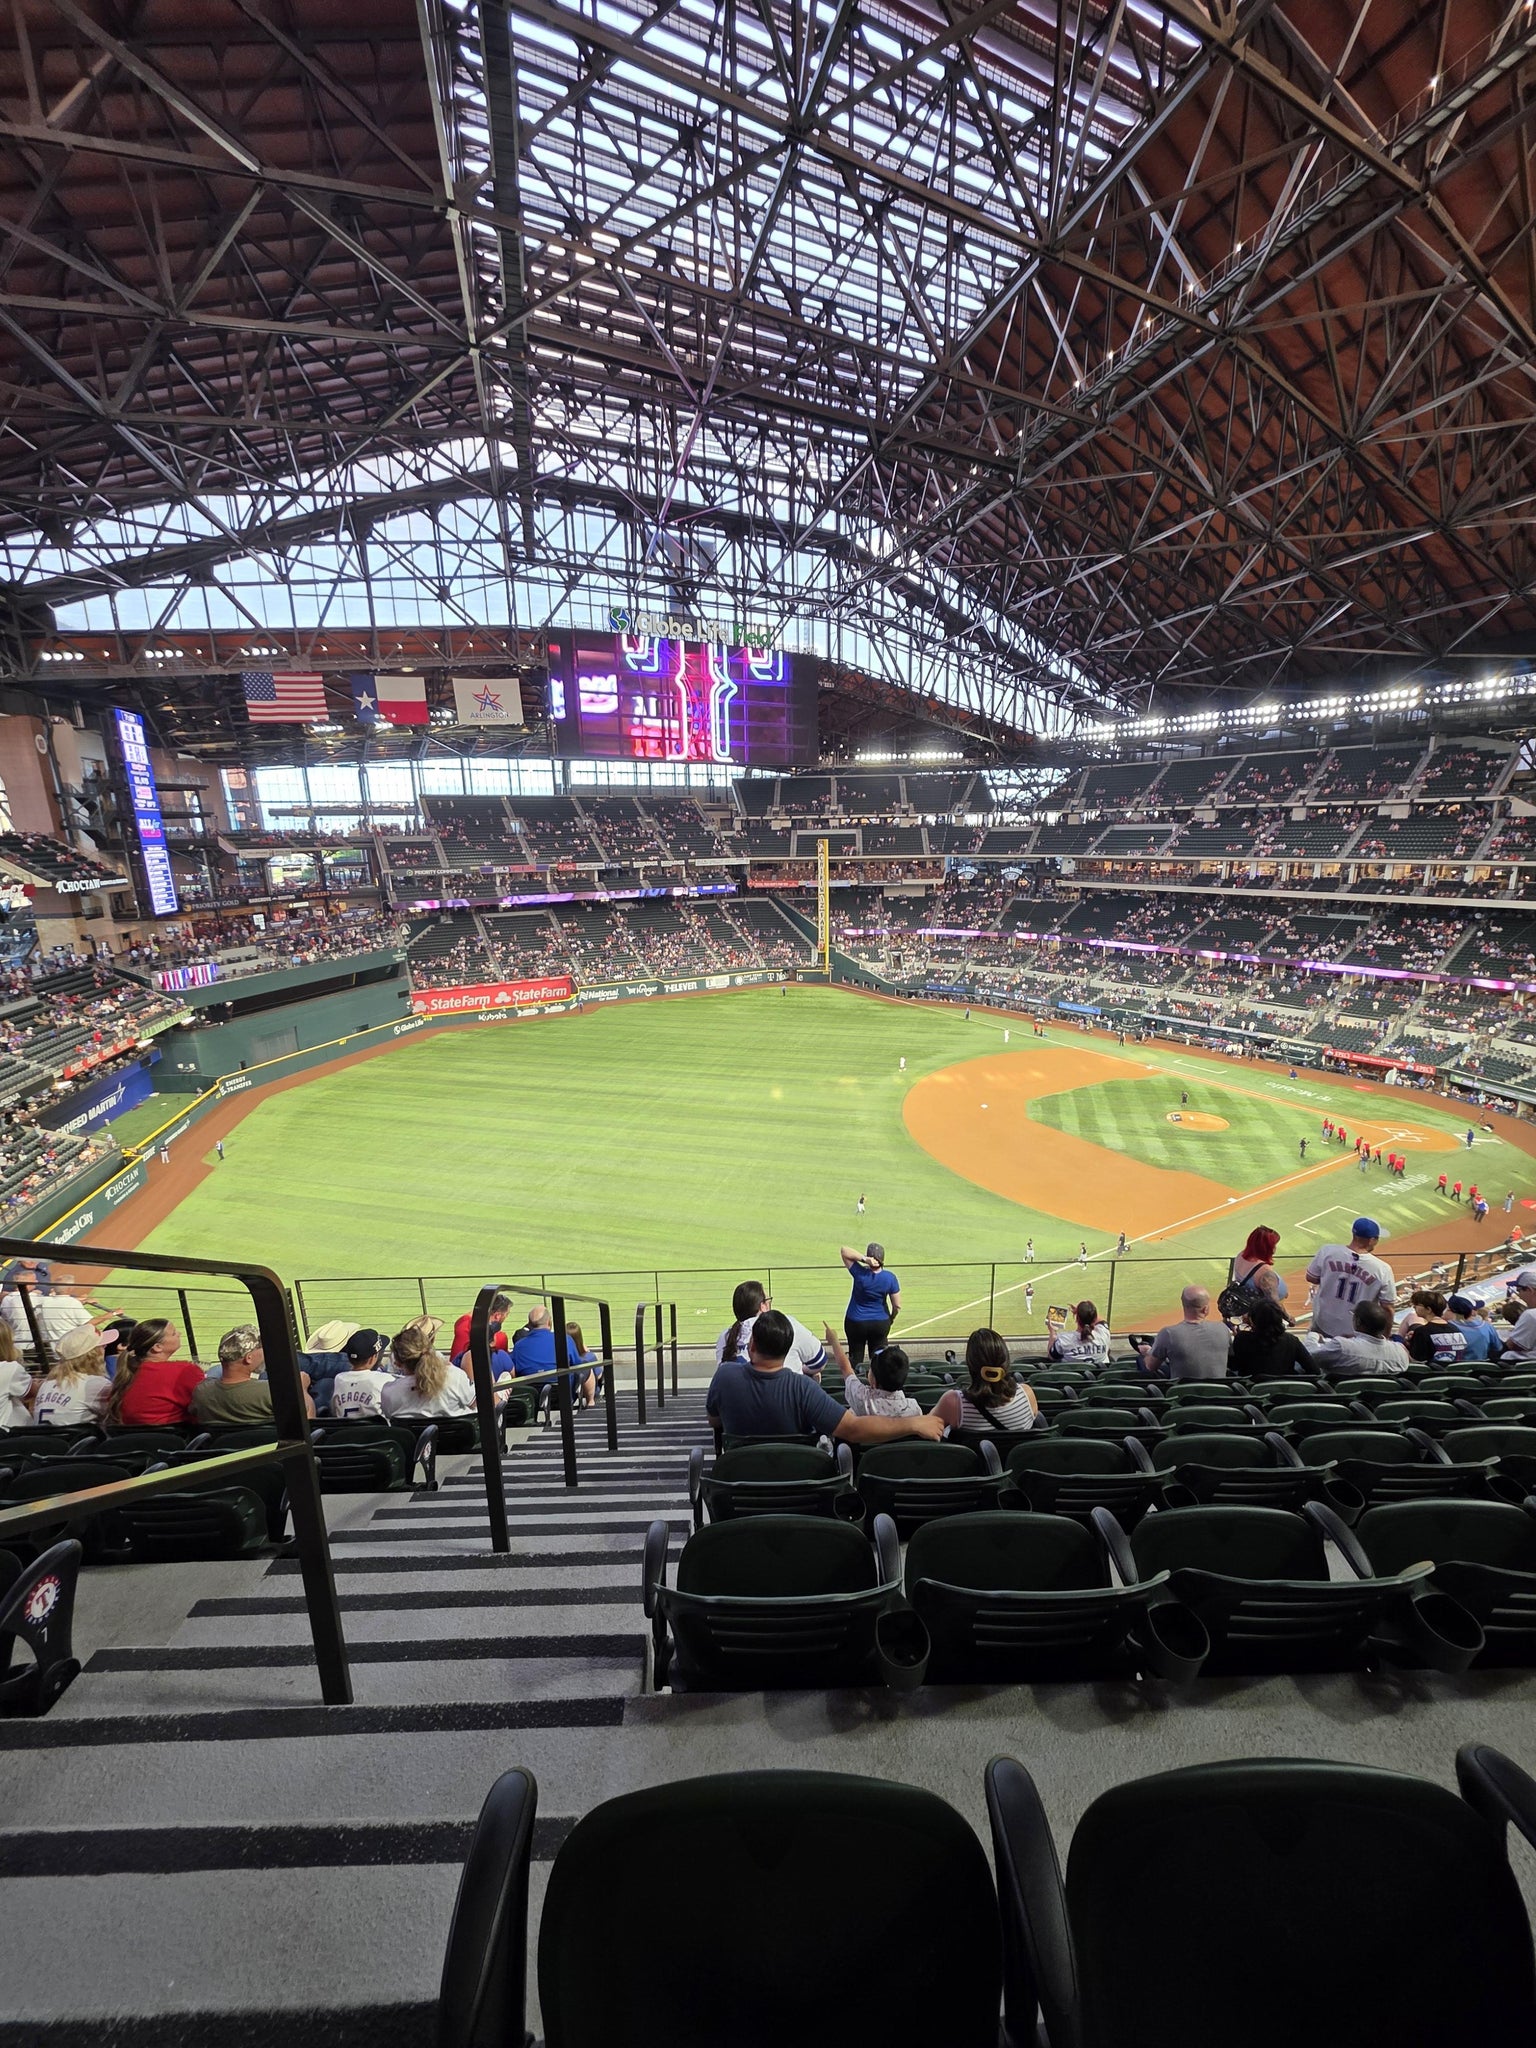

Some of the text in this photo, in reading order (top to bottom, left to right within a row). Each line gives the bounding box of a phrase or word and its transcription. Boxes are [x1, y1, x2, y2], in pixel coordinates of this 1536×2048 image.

[637, 613, 771, 646] Globe Life Field
[470, 712, 509, 720] ARLINGTON
[56, 879, 100, 893] CHOCTAW
[191, 902, 221, 910] PRIORITY
[221, 899, 240, 907] GOLD
[588, 988, 620, 999] National
[478, 1012, 507, 1021] Kubota
[400, 1018, 424, 1032] Globe Life
[225, 1076, 246, 1087] ENERGY
[226, 1080, 252, 1093] TRANSFER
[88, 1095, 117, 1120] MARTIN
[105, 1167, 139, 1200] CHOCTAW
[79, 1211, 93, 1228] City
[1335, 1277, 1360, 1304] 11
[1433, 1332, 1467, 1345] TEXA
[1071, 1344, 1107, 1356] SEMIEN
